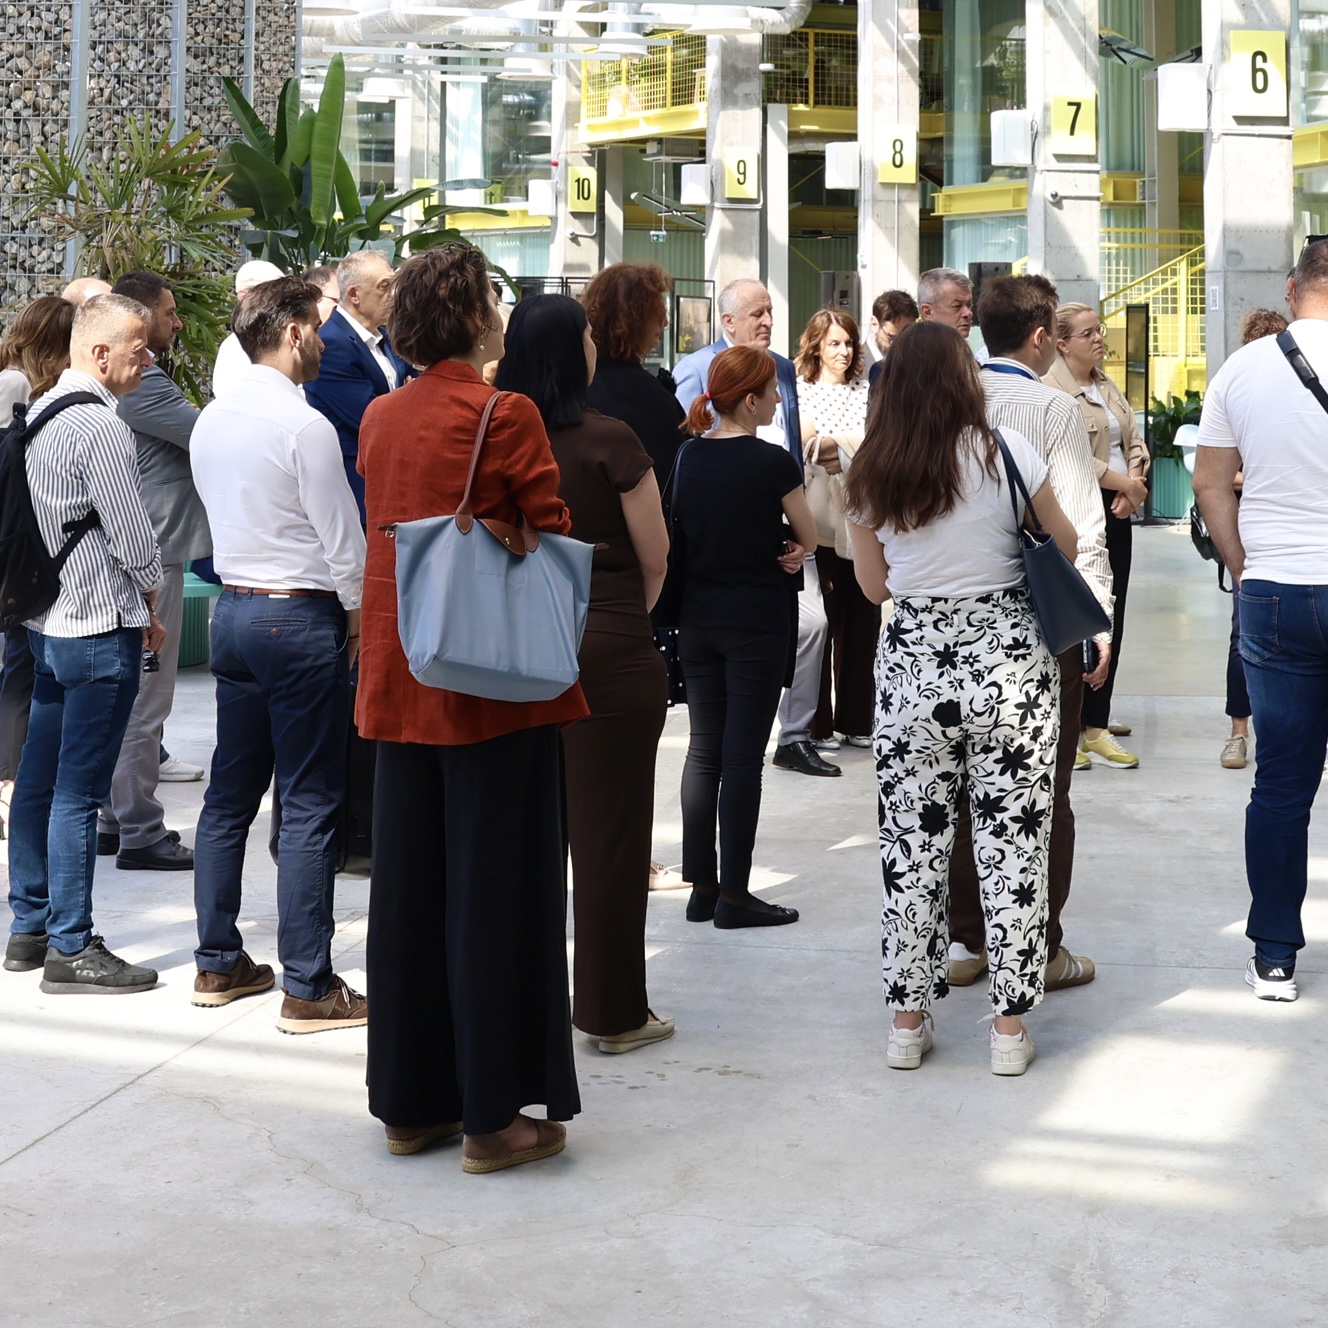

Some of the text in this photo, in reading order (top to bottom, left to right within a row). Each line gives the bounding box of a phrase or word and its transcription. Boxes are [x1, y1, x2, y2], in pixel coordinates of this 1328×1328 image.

[1251, 50, 1269, 94] 6
[1066, 101, 1082, 136] 7
[892, 138, 904, 169] 8
[736, 158, 748, 186] 9
[574, 177, 591, 201] 10
